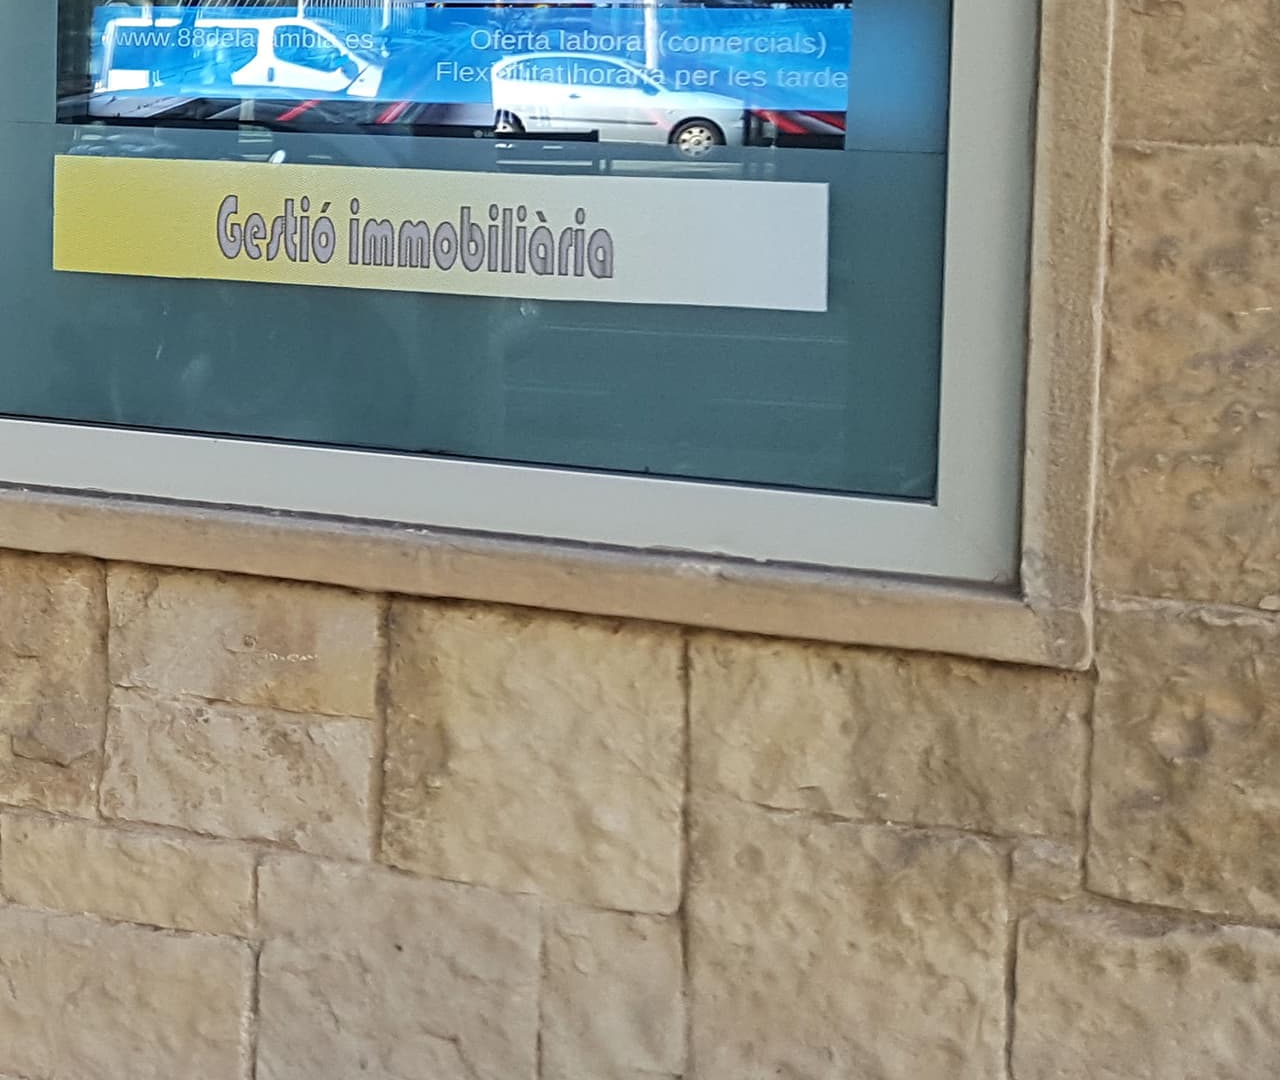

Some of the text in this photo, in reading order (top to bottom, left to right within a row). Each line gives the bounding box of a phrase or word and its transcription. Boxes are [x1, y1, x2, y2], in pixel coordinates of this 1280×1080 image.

[470, 29, 827, 59] Oferta labora (comercials)
[436, 61, 564, 84] Flexbilitat
[675, 69, 721, 92] per
[729, 66, 768, 87] les
[216, 194, 614, 280] Gestió immobiliària
